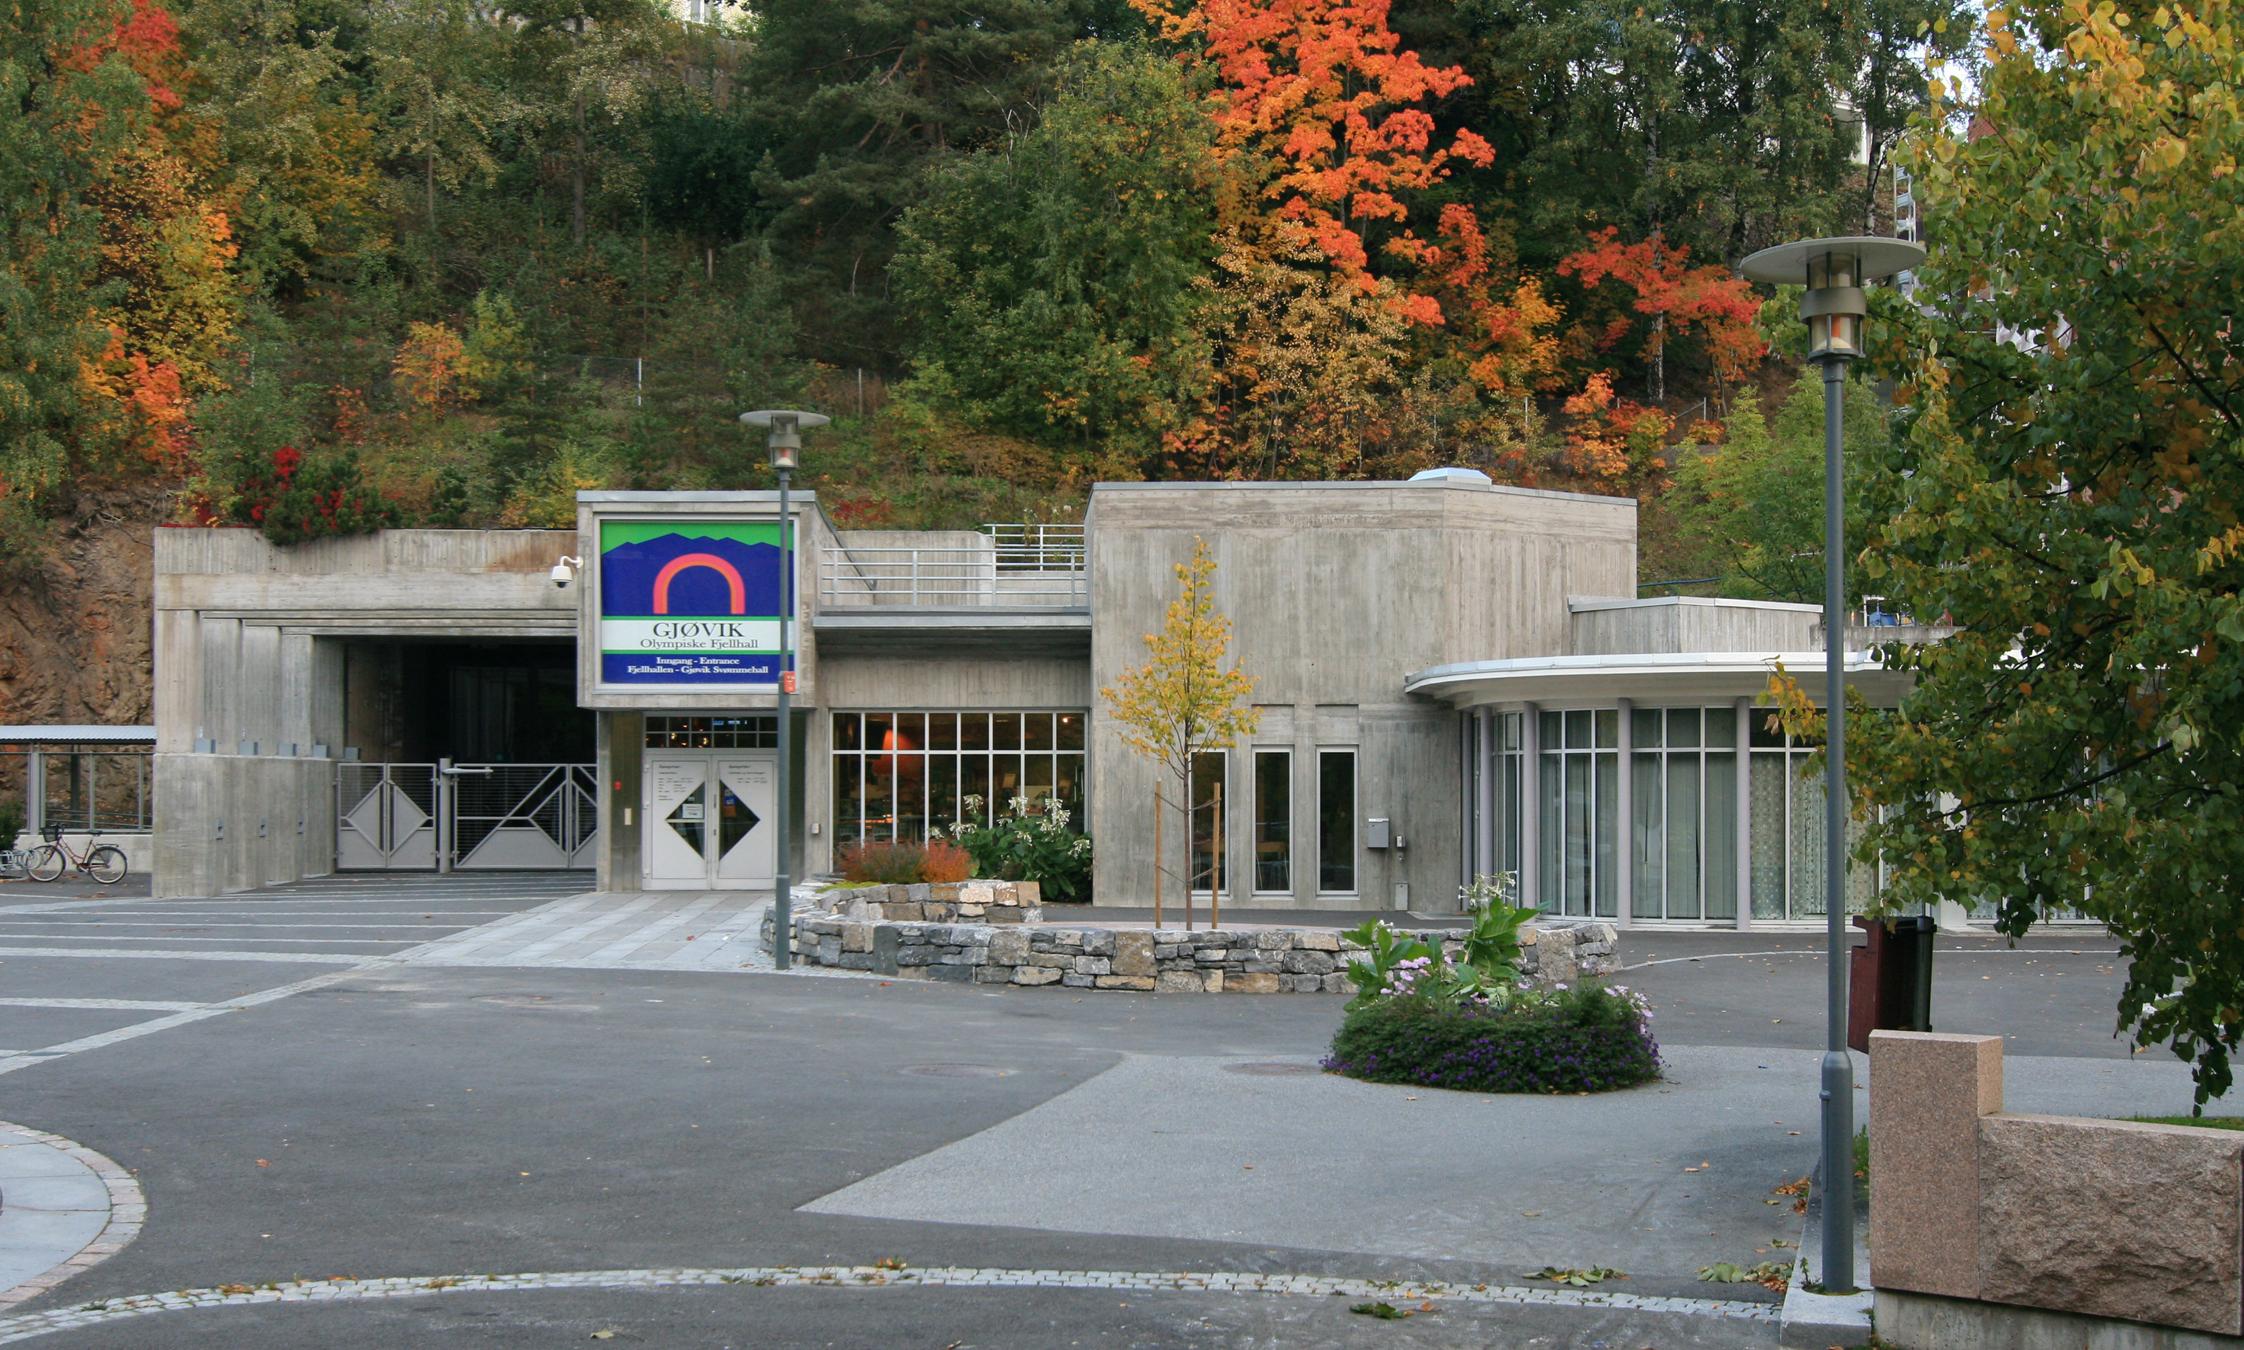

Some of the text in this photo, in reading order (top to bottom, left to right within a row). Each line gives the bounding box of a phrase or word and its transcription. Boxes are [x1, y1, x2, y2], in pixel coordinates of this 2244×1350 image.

[653, 622, 744, 639] GJØVIK
[640, 638, 759, 650] Olympiske Fjellhall
[656, 656, 693, 665] Inngang
[699, 656, 740, 664] Entrance
[627, 665, 674, 674] Fjellhallen
[680, 665, 711, 674] Gjøvik
[713, 665, 769, 674] Svømmehall
